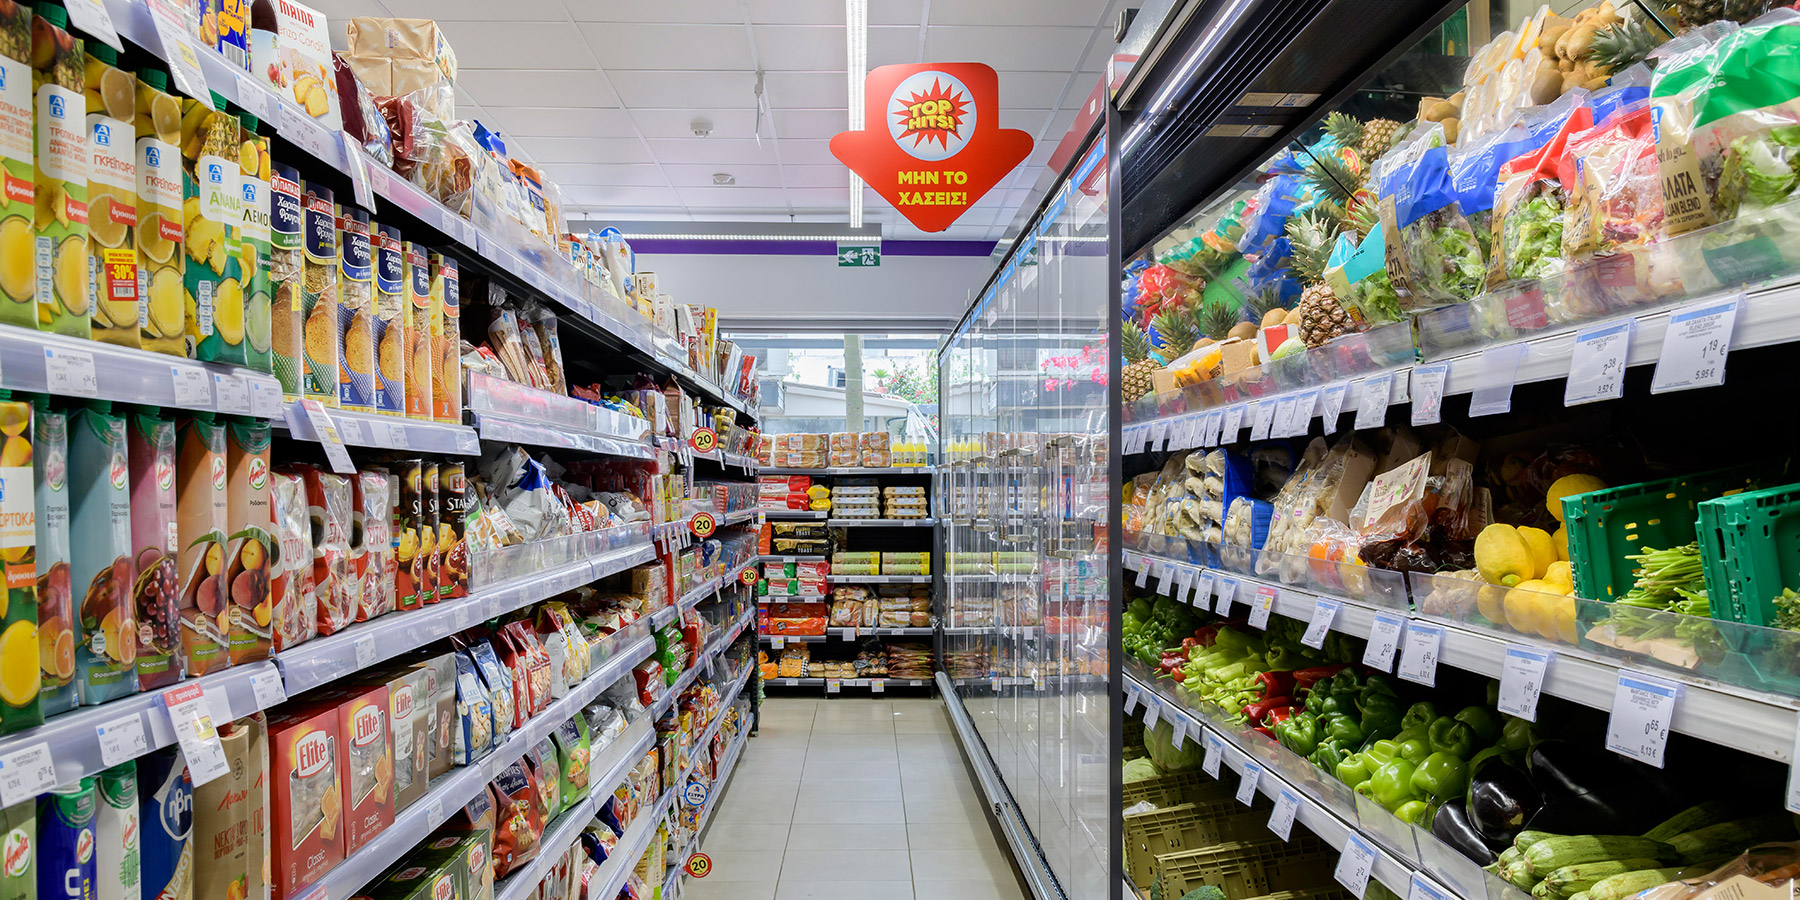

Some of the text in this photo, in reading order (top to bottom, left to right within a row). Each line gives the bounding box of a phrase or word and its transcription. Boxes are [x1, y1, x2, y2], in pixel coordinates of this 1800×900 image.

[279, 0, 315, 28] MAINA
[908, 99, 954, 116] TOP
[908, 114, 956, 131] HITS!
[898, 171, 968, 185] ΜΗΝ ΤΟ
[898, 191, 968, 206] ΧΑΣΕΙΣ!
[1679, 196, 1701, 214] BLEND
[111, 264, 135, 280] -30%
[1720, 344, 1726, 356] €
[1617, 362, 1623, 373] €
[696, 434, 712, 446] 20
[696, 520, 711, 530] 20
[744, 571, 755, 580] 30
[395, 690, 412, 715] Elite
[356, 713, 379, 741] Elite
[1660, 728, 1666, 741] €
[299, 741, 327, 771] Elite
[363, 811, 380, 829] Classic
[307, 848, 326, 870] Classic
[692, 859, 707, 872] 20
